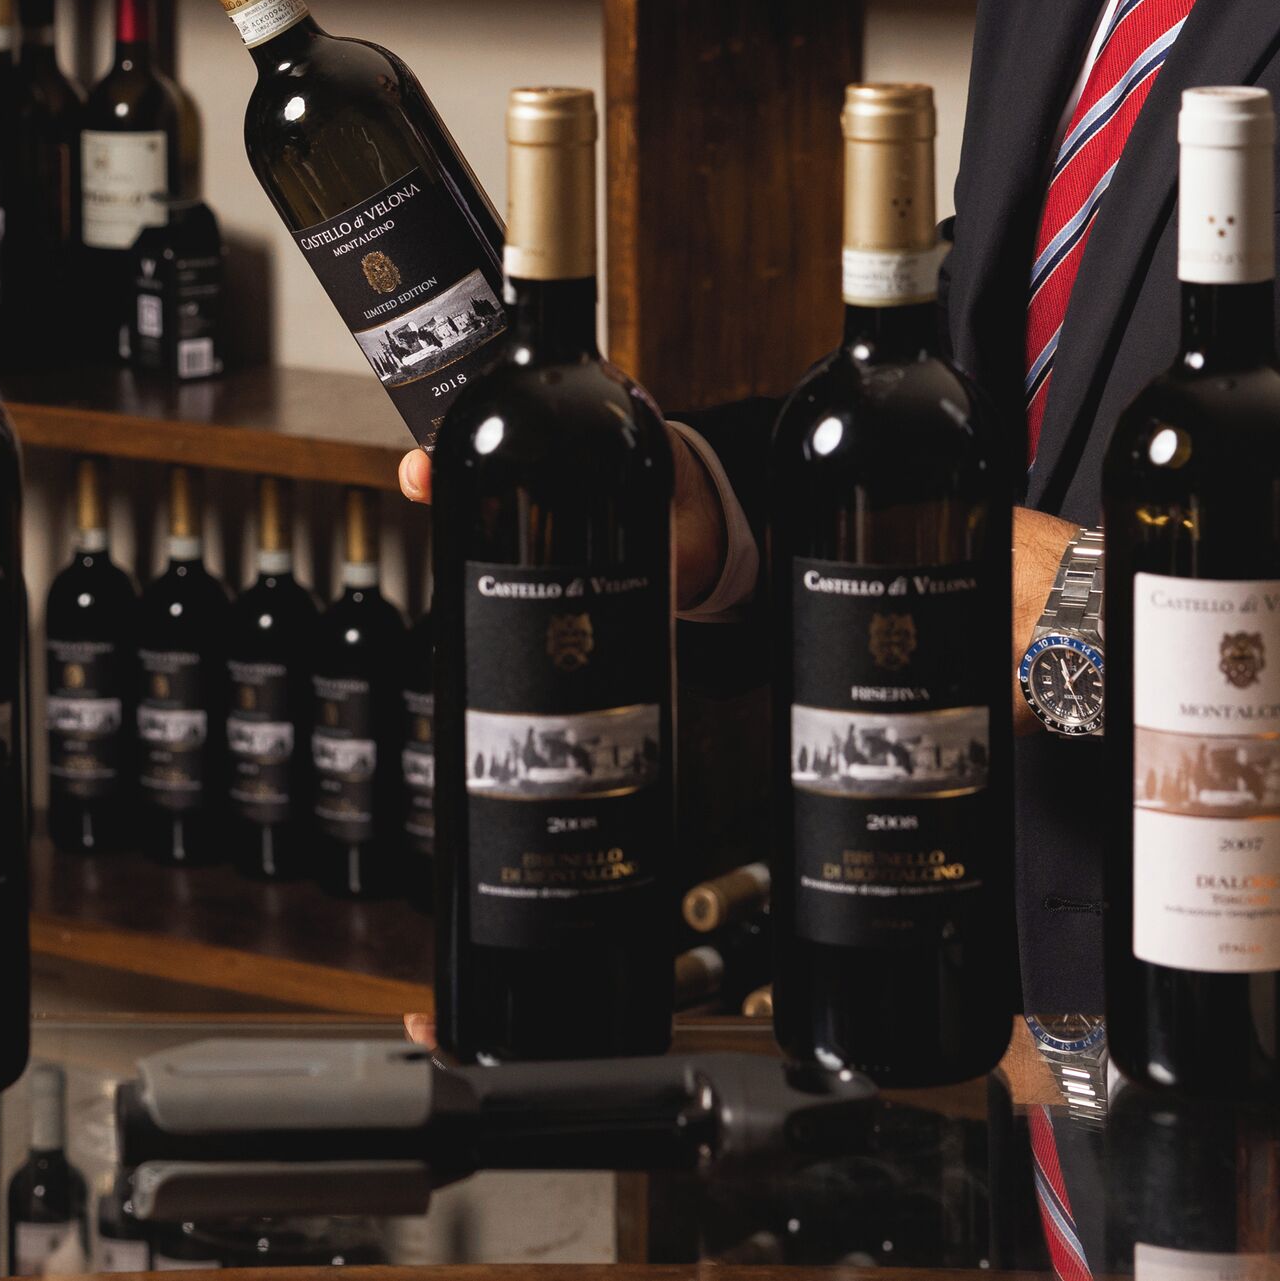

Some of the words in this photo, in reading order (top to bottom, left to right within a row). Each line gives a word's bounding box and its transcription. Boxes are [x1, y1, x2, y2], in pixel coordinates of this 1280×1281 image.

[300, 221, 352, 250] CASTELLO
[353, 215, 365, 229] di
[332, 219, 395, 257] MONTALCINO
[363, 299, 398, 320] LIMITED
[397, 276, 438, 304] EDITION
[431, 373, 468, 397] 2018
[478, 575, 563, 599] CASTELLO
[803, 570, 886, 597] CASTELLO
[912, 575, 977, 595] VELONA
[1150, 591, 1234, 613] CASTELLO
[1038, 639, 1049, 649] 10
[1059, 637, 1070, 646] 12
[1081, 644, 1091, 656] 14
[1024, 654, 1033, 662] 8
[851, 685, 930, 702] RISERVA
